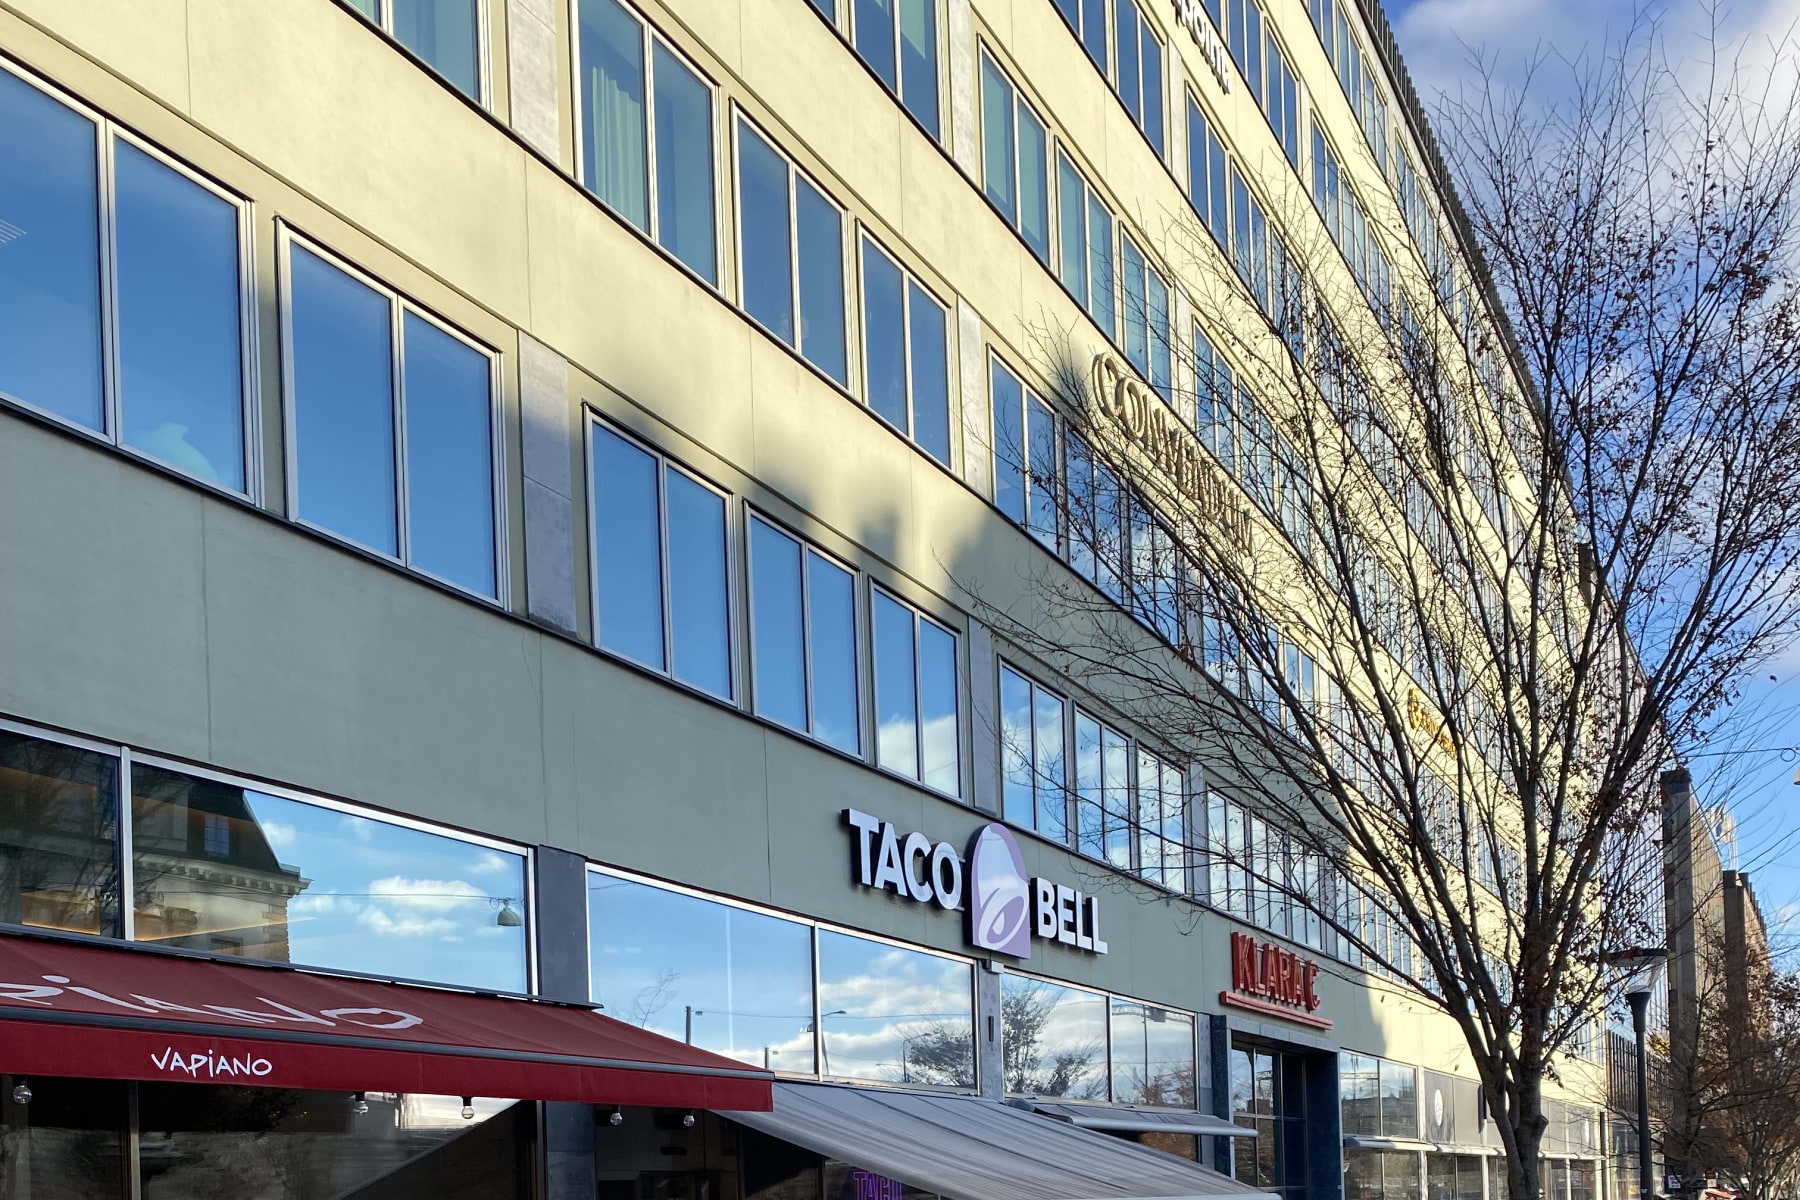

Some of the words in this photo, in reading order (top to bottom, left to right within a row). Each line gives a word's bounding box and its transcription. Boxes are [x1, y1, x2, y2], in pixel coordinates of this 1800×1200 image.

[845, 809, 964, 911] TACO
[1034, 877, 1108, 955] BELL
[1232, 931, 1306, 1006] KLARA
[1303, 960, 1321, 1011] C
